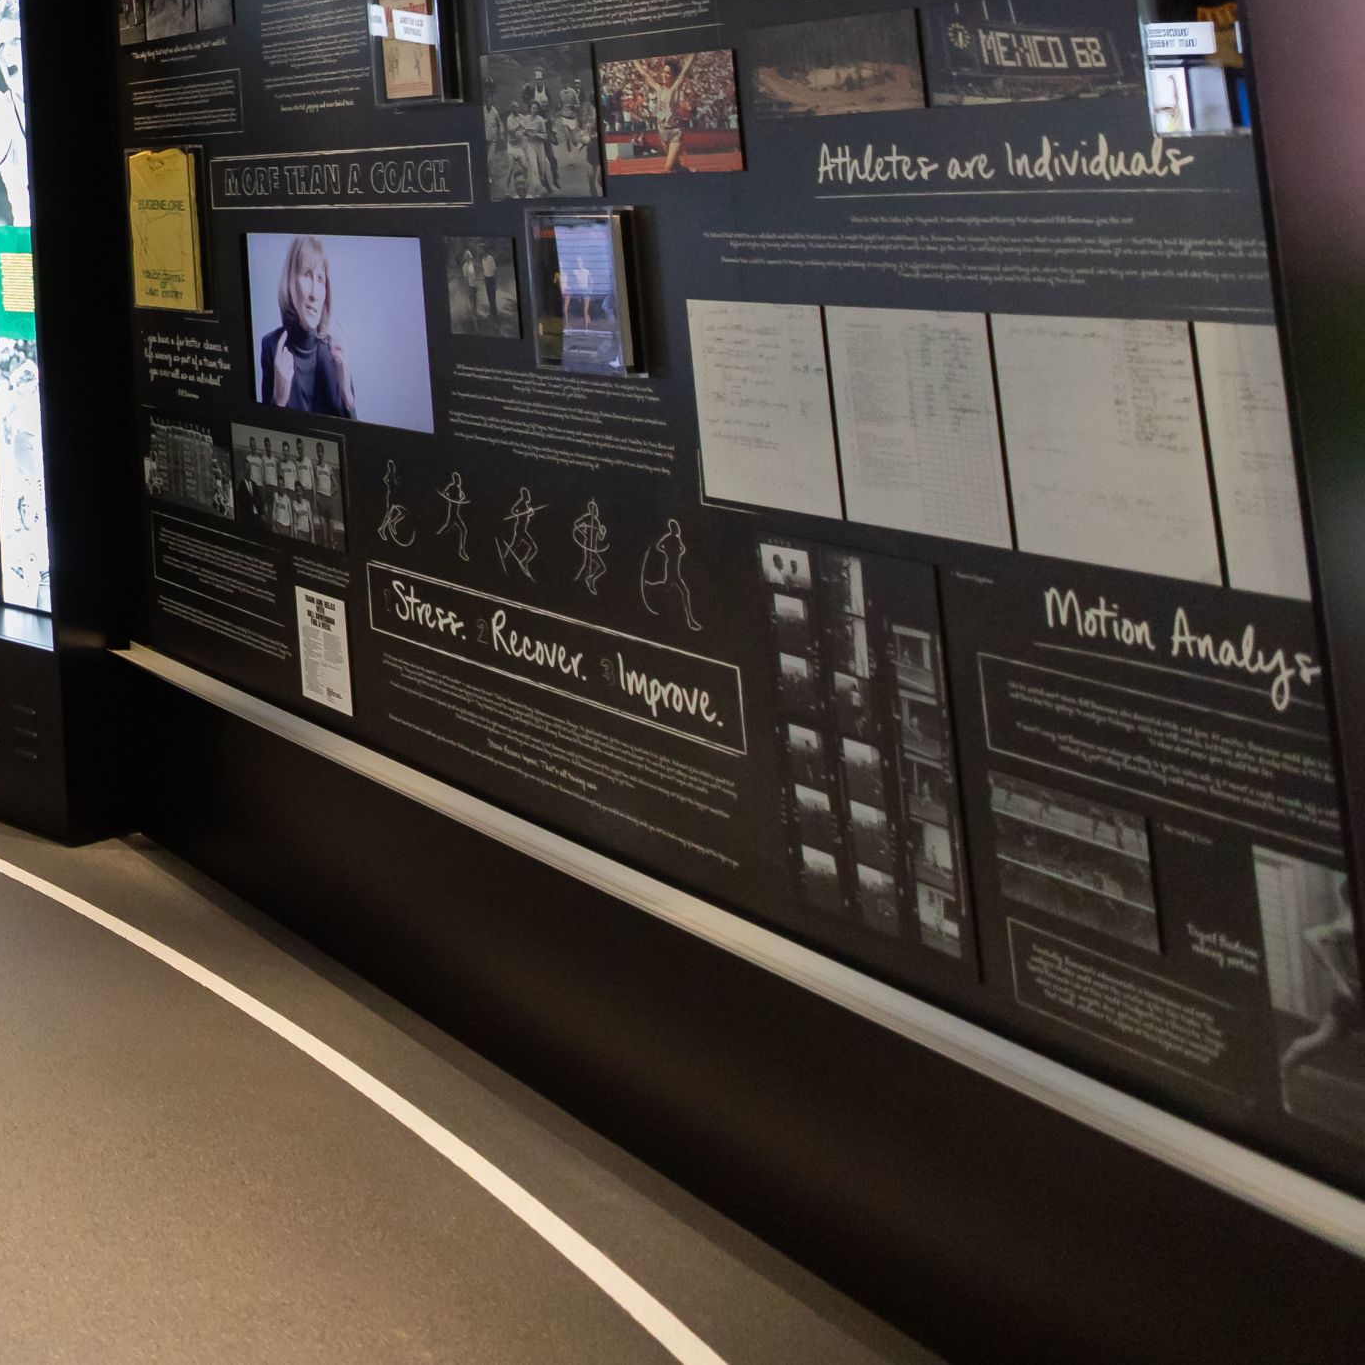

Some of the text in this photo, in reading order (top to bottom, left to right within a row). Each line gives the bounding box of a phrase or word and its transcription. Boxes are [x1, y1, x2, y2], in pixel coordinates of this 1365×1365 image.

[977, 28, 1069, 69] MEXICO
[1070, 36, 1108, 69] 68
[223, 158, 451, 196] MORE THAN A COACH
[817, 133, 1195, 185] Athletes are Individuals
[1044, 586, 1156, 651] Motion
[392, 580, 467, 641] Stress.
[491, 609, 587, 681] Recover.
[618, 652, 724, 727] Improve.
